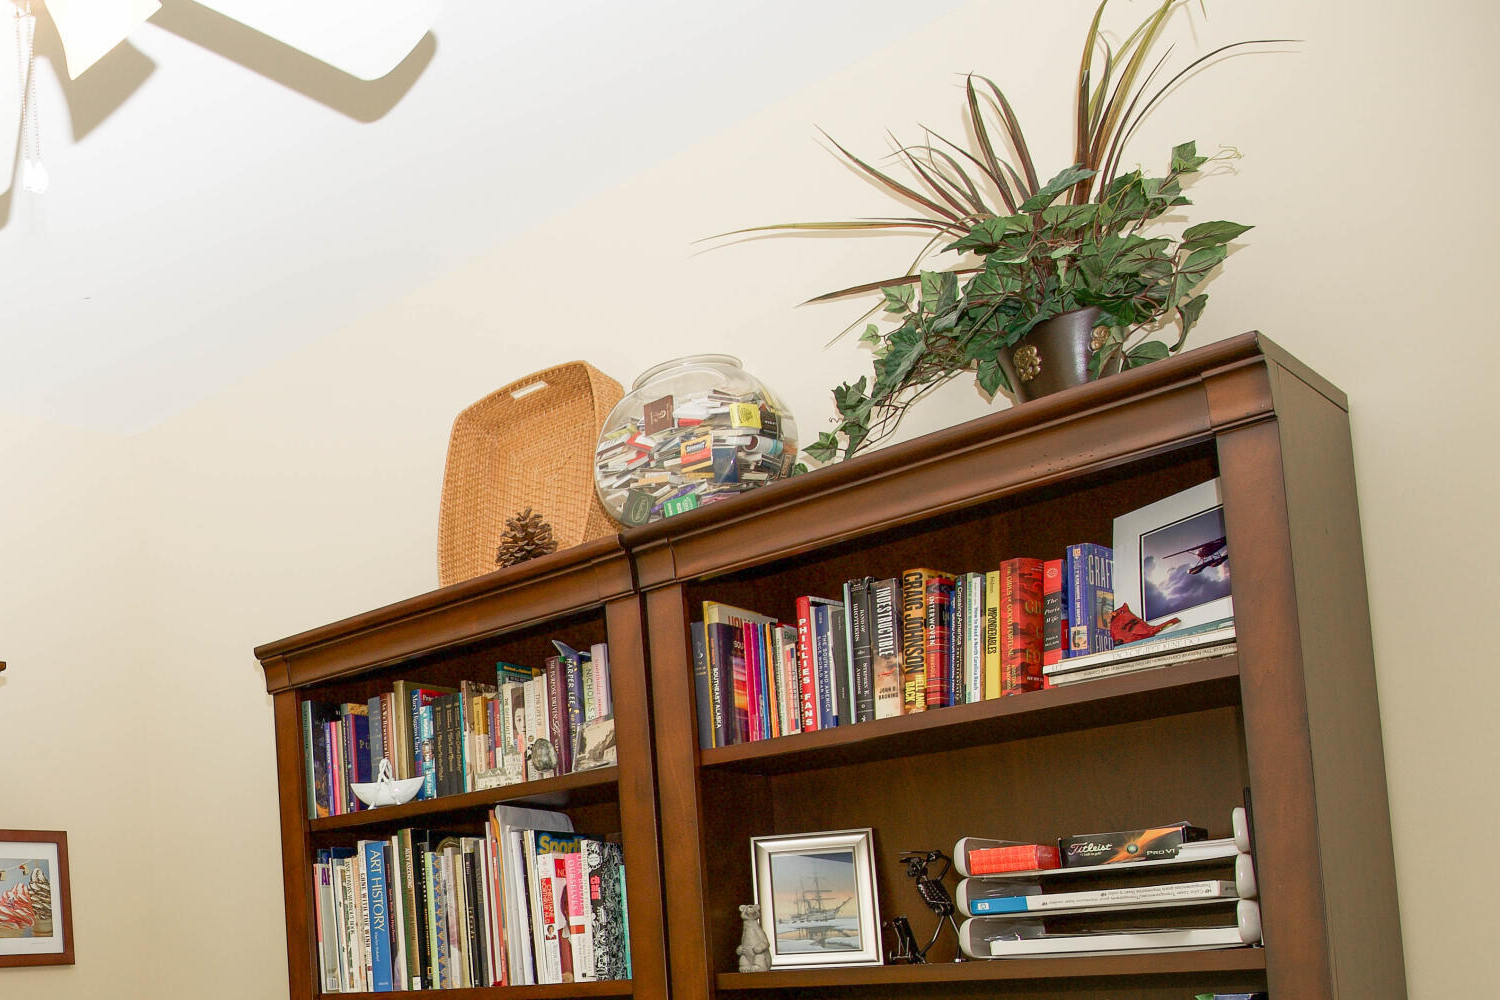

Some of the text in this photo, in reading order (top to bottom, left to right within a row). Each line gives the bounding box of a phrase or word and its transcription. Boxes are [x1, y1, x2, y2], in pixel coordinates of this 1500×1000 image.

[860, 624, 866, 632] OF
[876, 587, 894, 656] INDESTRUCTIBLE
[904, 572, 924, 674] CRAIG JOHNSON
[987, 607, 998, 654] IMPONDERABLES
[712, 668, 720, 704] SOUTHEAST
[798, 618, 813, 726] PHILLIES FANS
[905, 682, 916, 702] BACK
[916, 675, 924, 708] HELL AND
[1068, 842, 1112, 856] Titleist
[370, 850, 385, 932] ART HISTORY
[568, 860, 578, 910] OURSELVES
